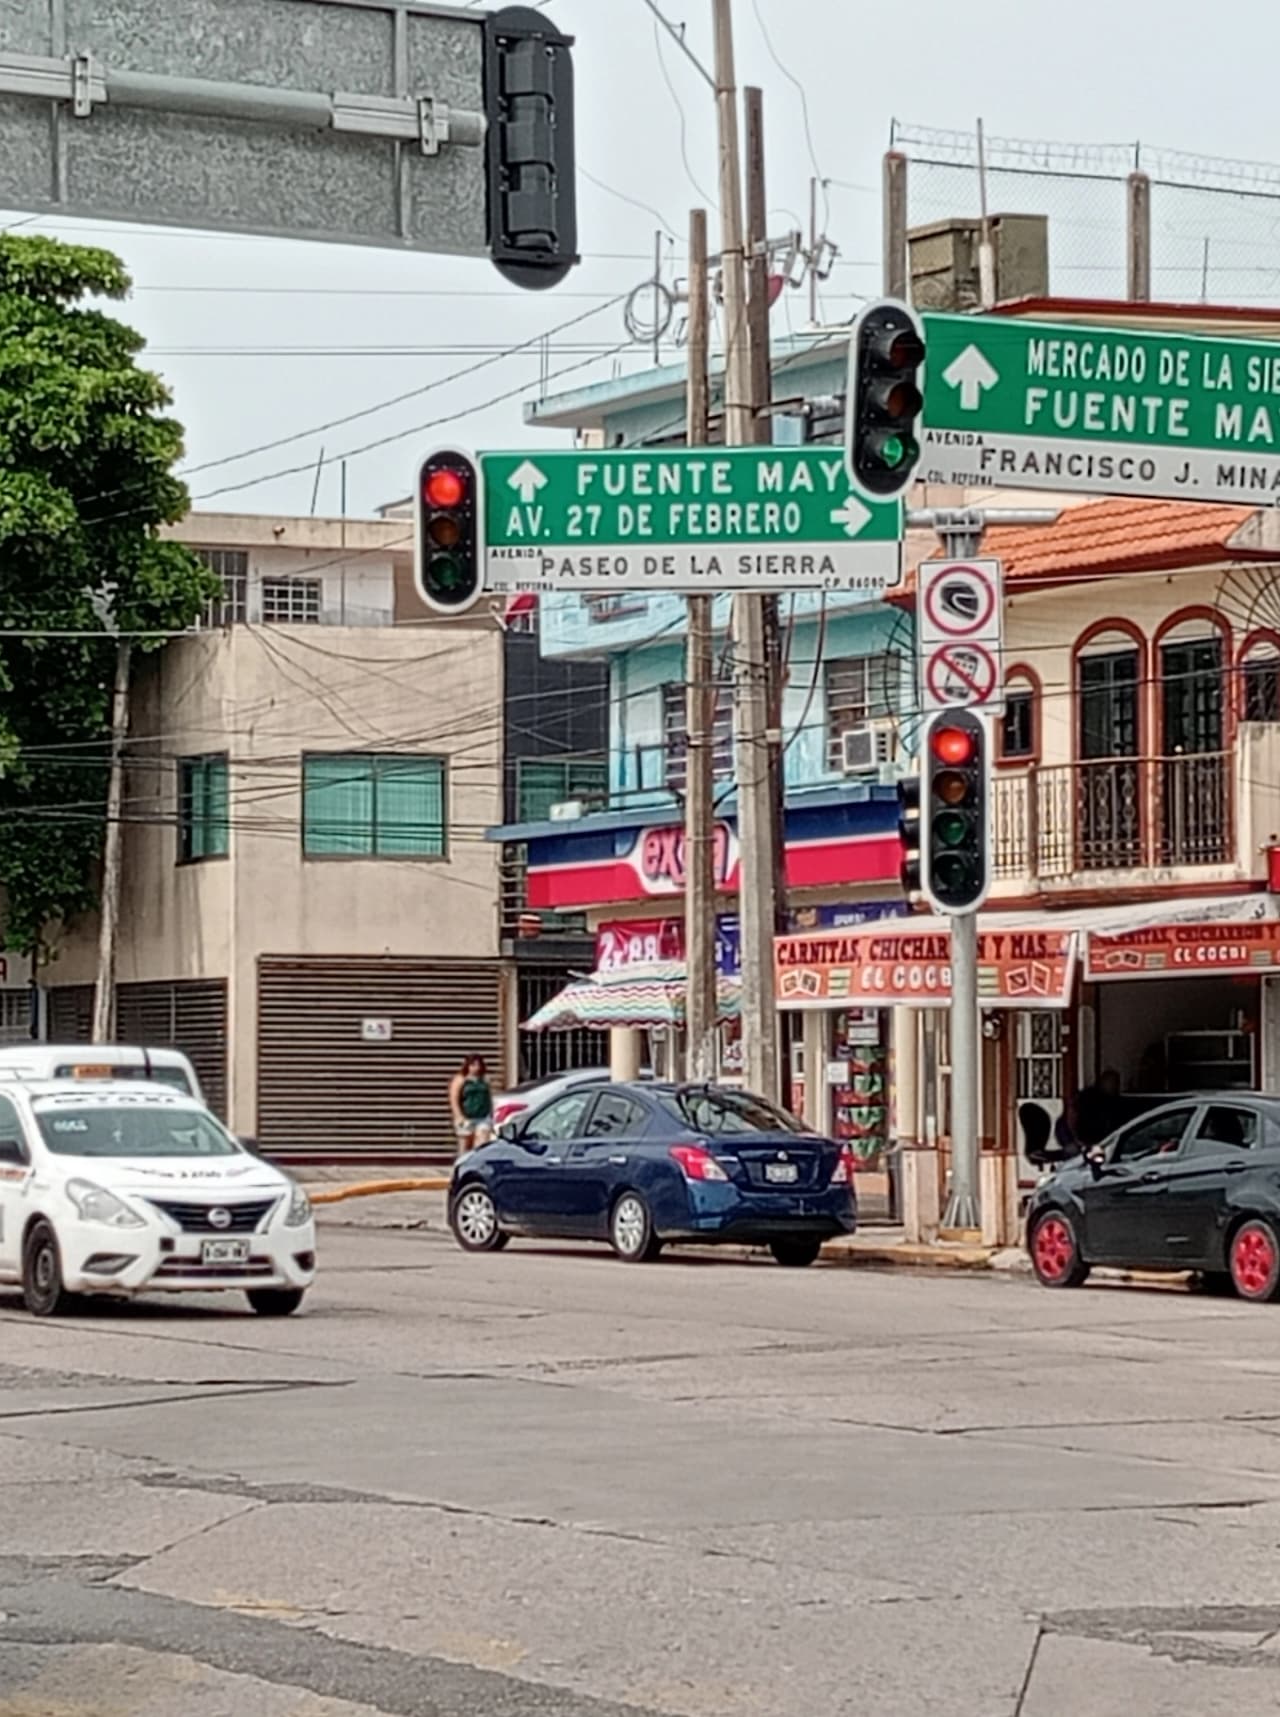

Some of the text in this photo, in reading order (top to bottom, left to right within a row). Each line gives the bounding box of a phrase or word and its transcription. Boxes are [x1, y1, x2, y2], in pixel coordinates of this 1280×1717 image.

[1027, 338, 1146, 383] MERCADO
[1160, 349, 1190, 387] DE
[1204, 352, 1233, 390] LA
[1025, 387, 1190, 437] FUENTE
[926, 431, 984, 446] AVENIDA
[577, 460, 854, 495] FUENTE MAY
[980, 448, 1155, 481] FRANCISCO
[1174, 461, 1199, 485] J.
[506, 503, 801, 538] AV. 27 DE FEBRERO
[491, 548, 544, 559] AVENIDA
[541, 554, 836, 577] PASEO DE LA SIERRA
[777, 937, 862, 967] CARNITAS,
[990, 935, 1005, 960] Y
[861, 966, 885, 990] EL
